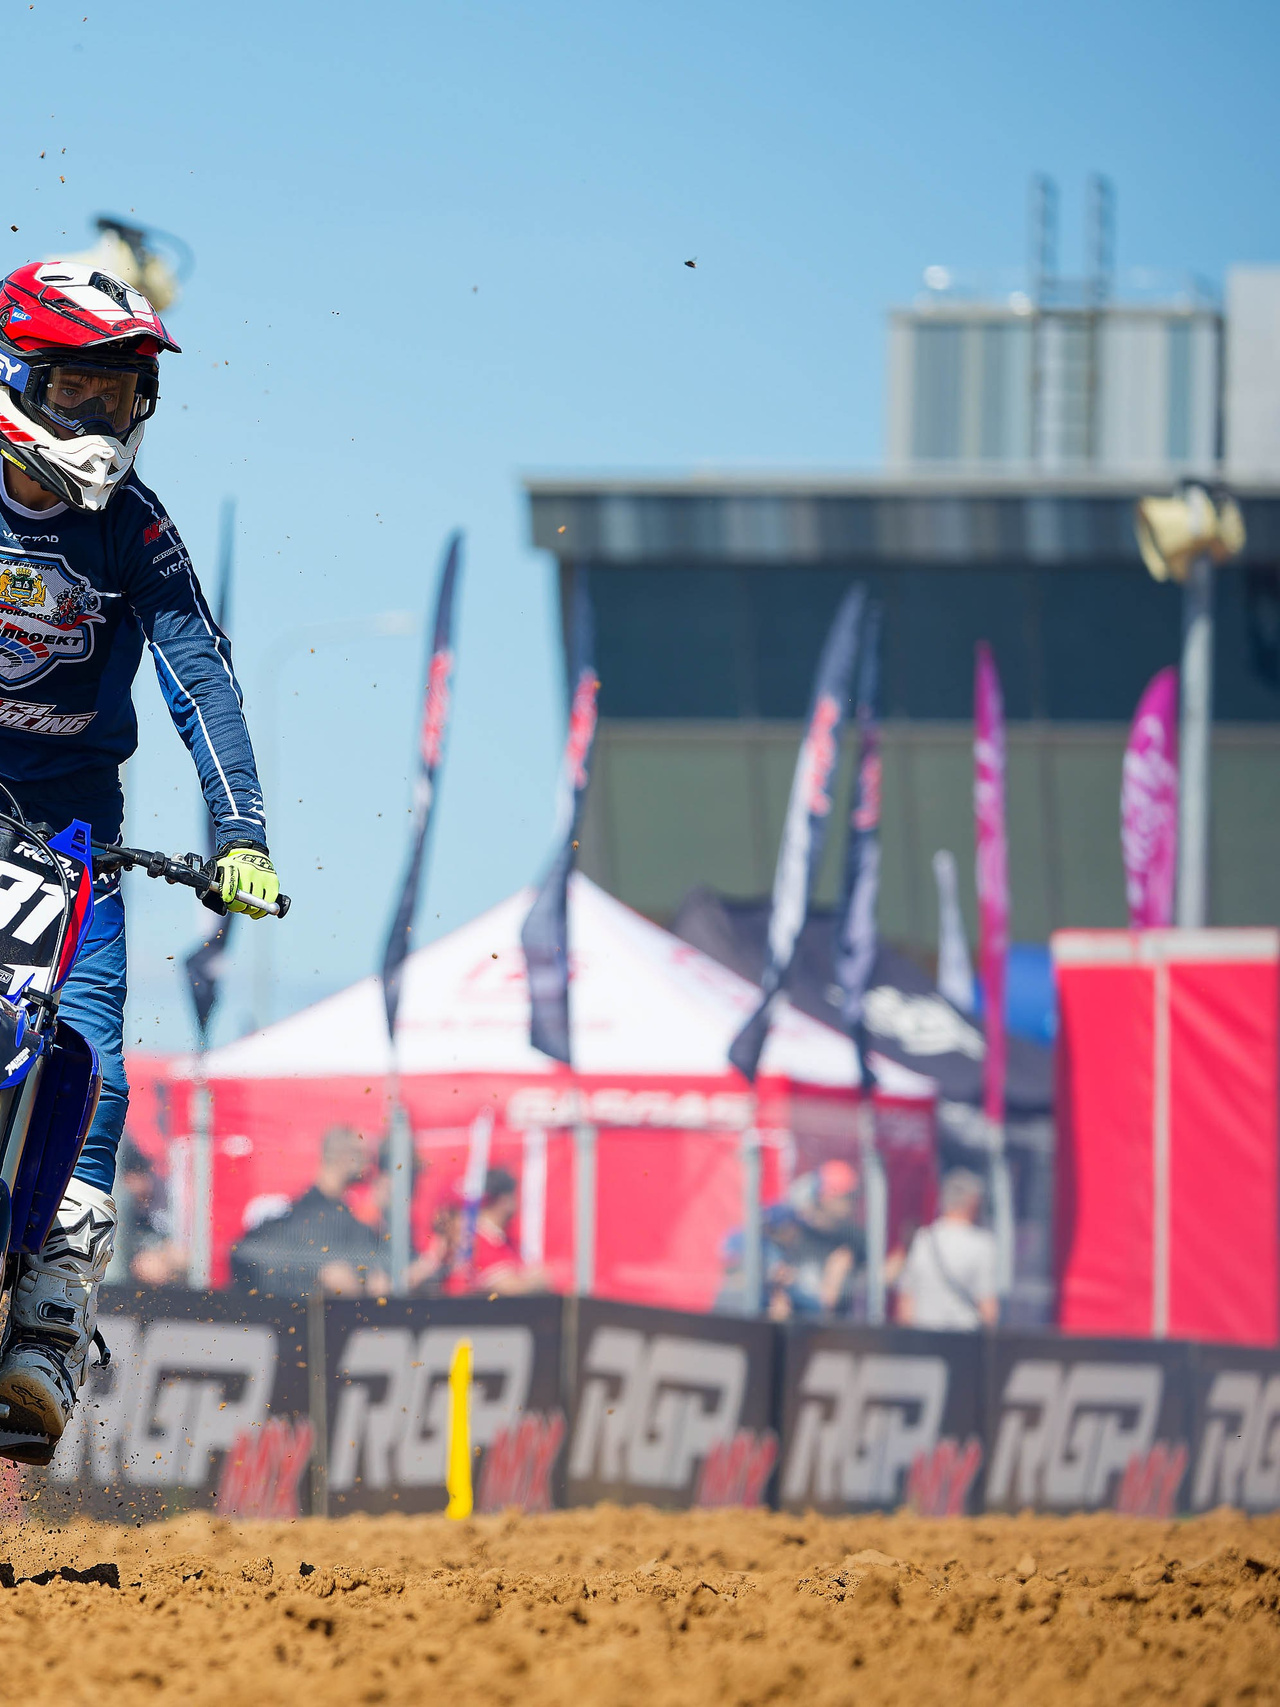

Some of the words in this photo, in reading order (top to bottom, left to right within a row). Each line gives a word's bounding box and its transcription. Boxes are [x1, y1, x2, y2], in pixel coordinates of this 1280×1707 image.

[327, 1326, 535, 1490] RGP
[567, 1325, 749, 1490] RGP
[781, 1350, 949, 1501] RGP
[987, 1361, 1165, 1505] RGP
[1191, 1370, 1280, 1509] RG
